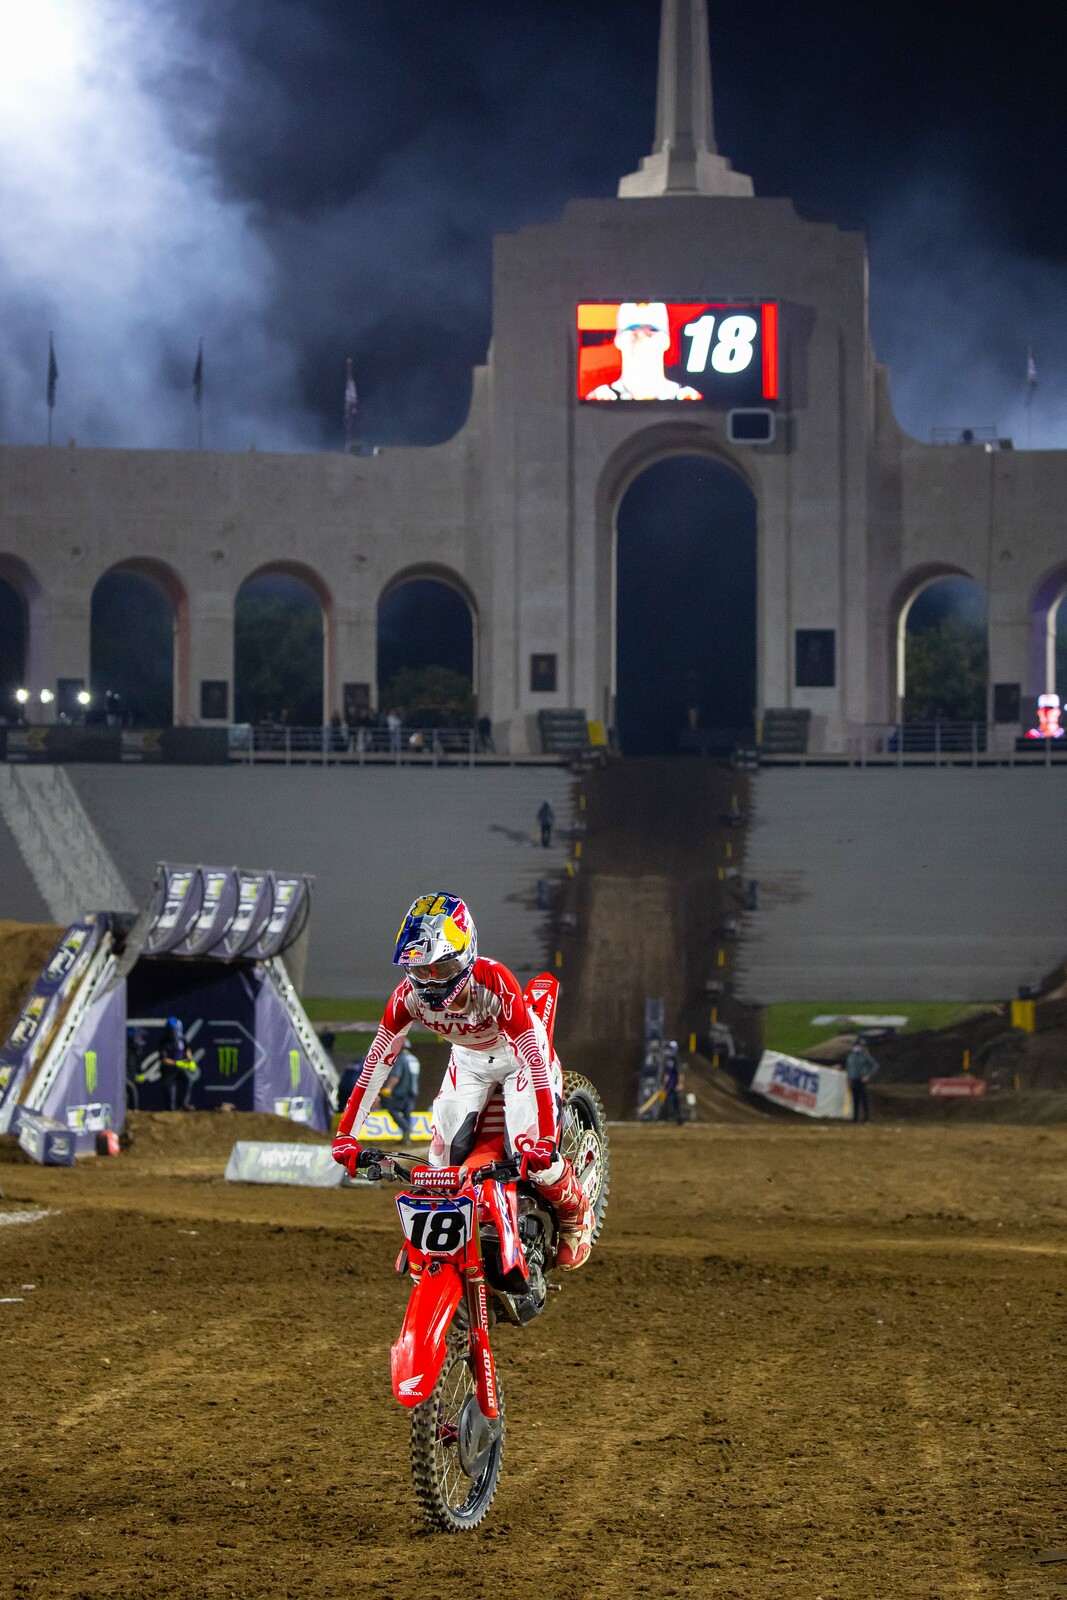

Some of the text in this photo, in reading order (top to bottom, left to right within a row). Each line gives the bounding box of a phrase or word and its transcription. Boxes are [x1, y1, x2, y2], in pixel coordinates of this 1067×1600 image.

[684, 315, 758, 373] 18
[442, 983, 462, 1008] Red
[410, 1211, 465, 1251] 18
[482, 1348, 495, 1408] DUNLOP
